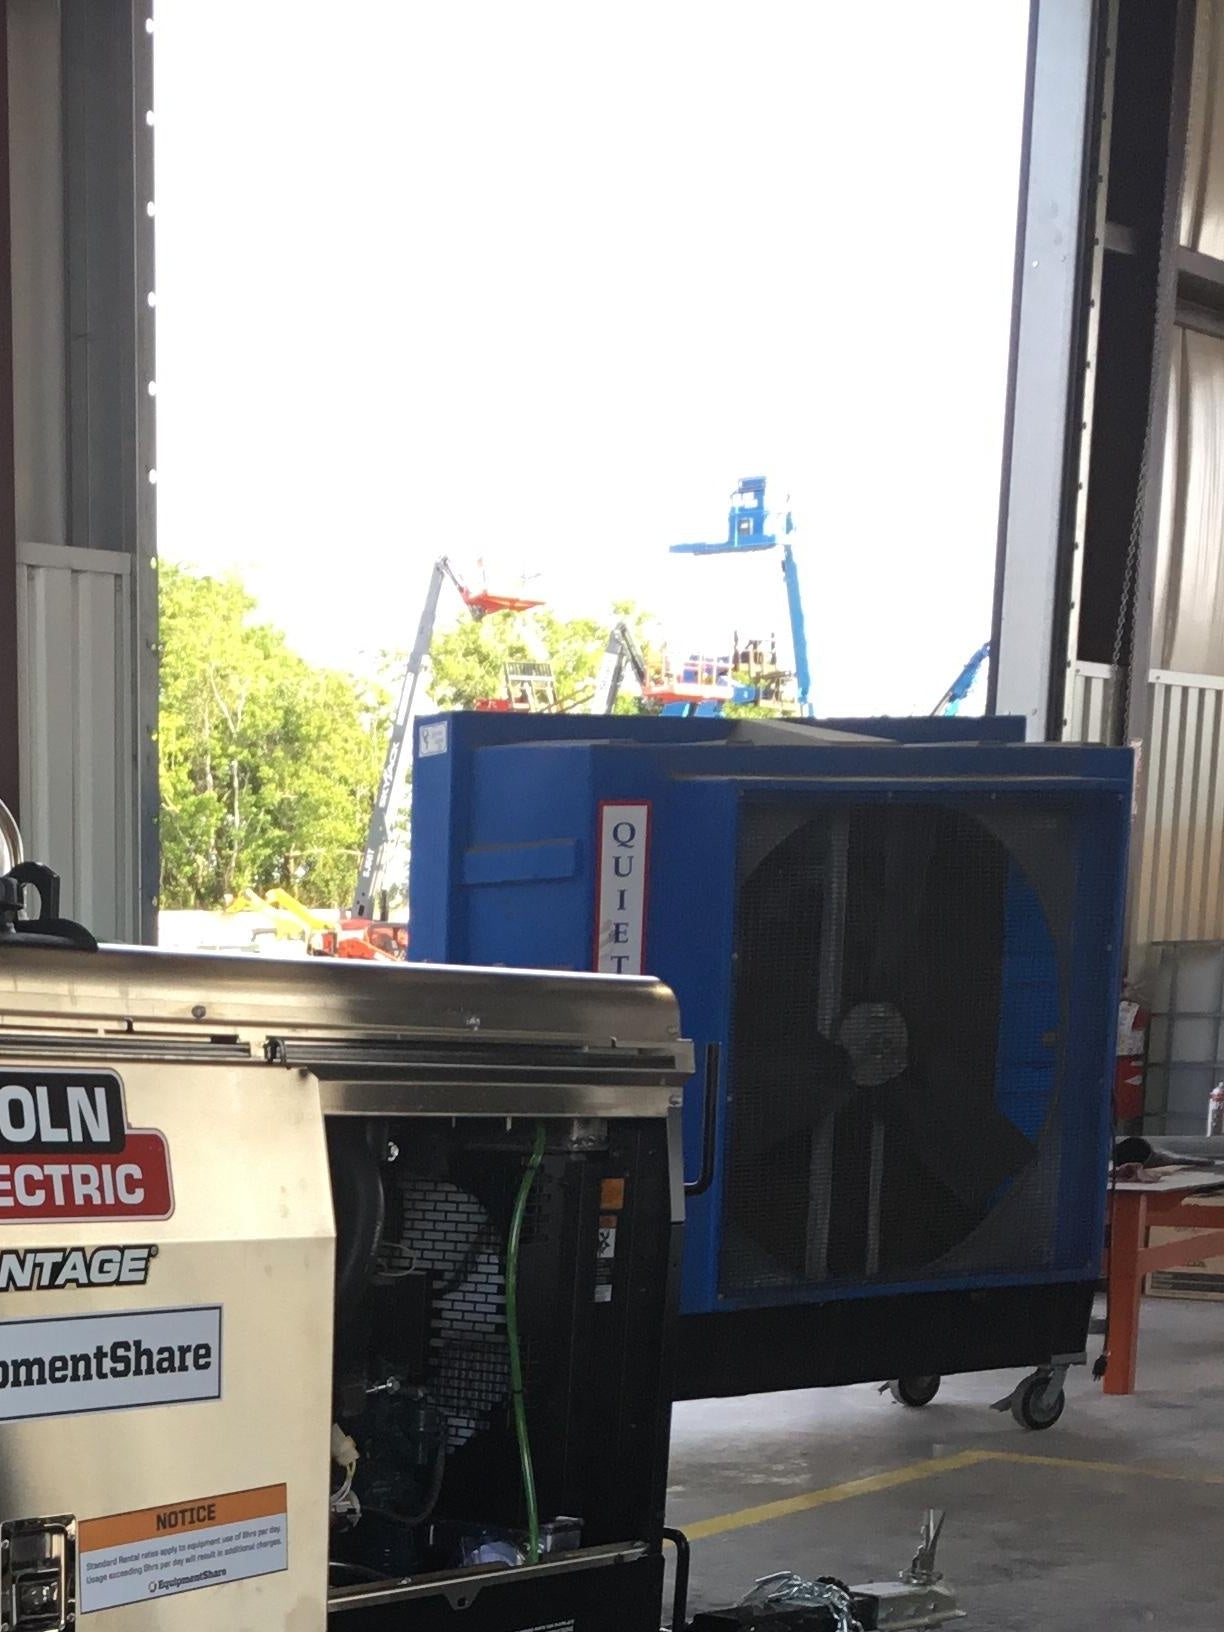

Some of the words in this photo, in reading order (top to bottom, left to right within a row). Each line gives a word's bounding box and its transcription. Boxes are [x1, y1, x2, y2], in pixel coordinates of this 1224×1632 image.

[379, 741, 401, 808] SKYJACK
[610, 821, 637, 973] QUIET
[156, 1503, 217, 1532] NOTICE
[86, 1557, 118, 1571] Standard
[118, 1552, 140, 1564] Rental
[141, 1550, 159, 1559] rates
[160, 1546, 178, 1556] apply
[178, 1544, 186, 1552] to
[187, 1536, 221, 1551] equipment
[222, 1535, 234, 1543] use
[234, 1532, 242, 1541] of
[257, 1528, 269, 1537] per
[86, 1574, 107, 1585] Usage
[108, 1567, 143, 1579] exceeding
[160, 1560, 171, 1570] per
[172, 1558, 184, 1567] day
[185, 1554, 196, 1563] will
[197, 1550, 216, 1560] result
[224, 1542, 255, 1555] additional
[158, 1568, 227, 1590] EquipmentShare
